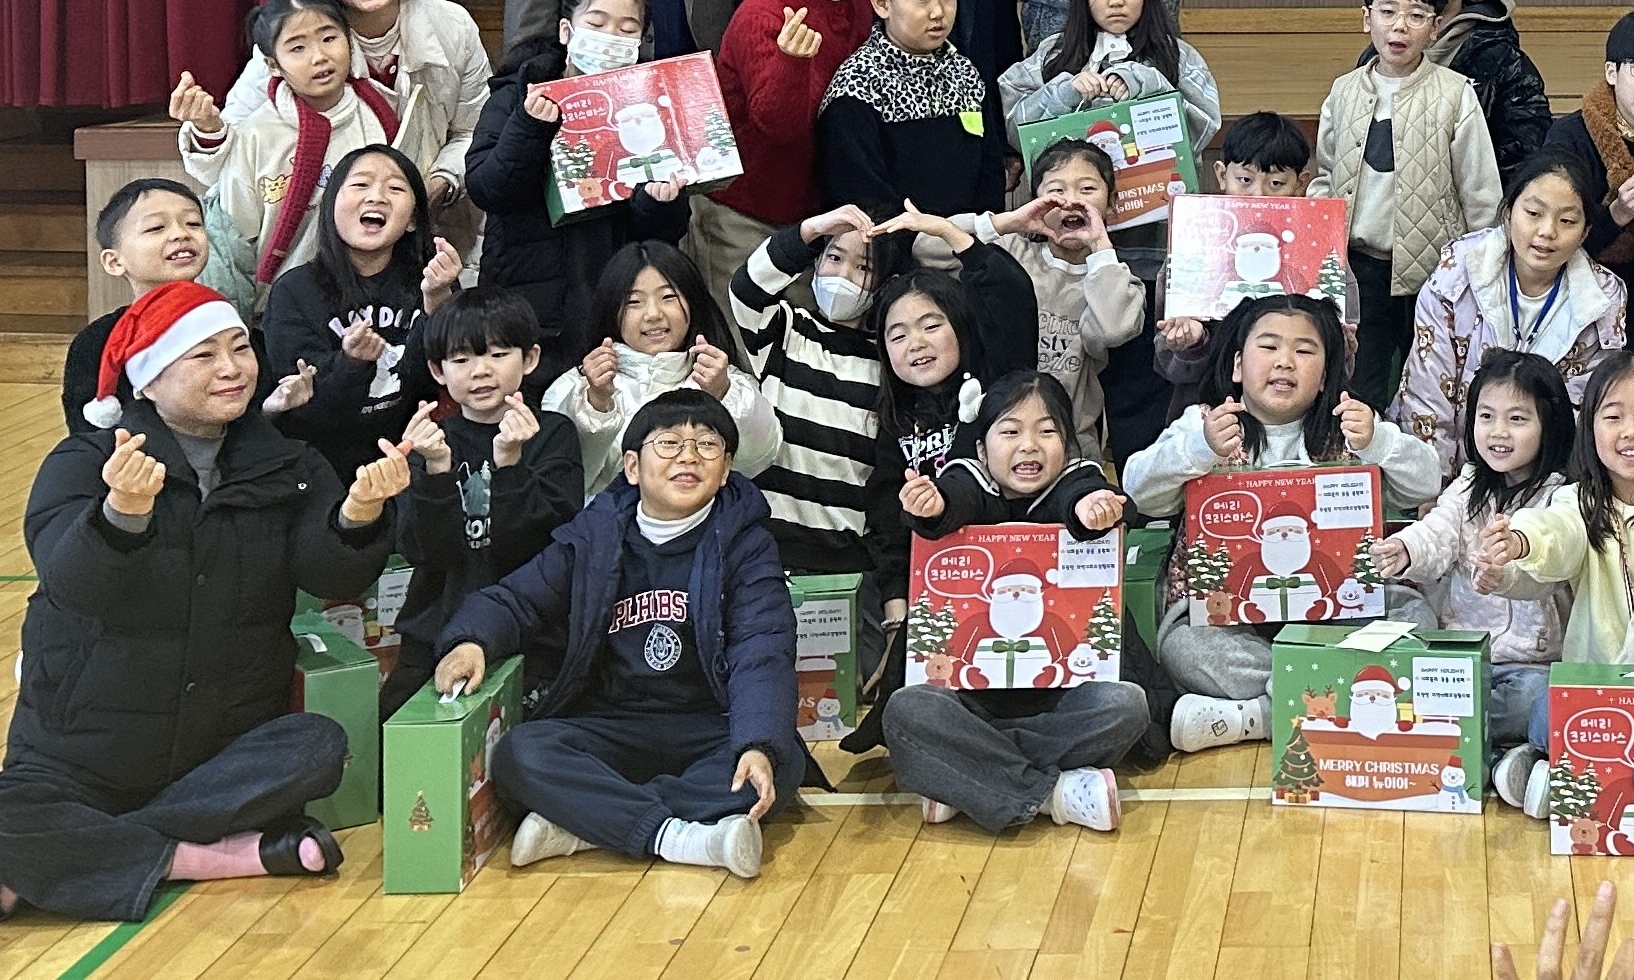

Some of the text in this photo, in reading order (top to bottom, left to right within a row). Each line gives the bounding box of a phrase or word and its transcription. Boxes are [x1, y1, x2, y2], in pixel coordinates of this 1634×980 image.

[1246, 479, 1274, 488] HAPPY
[1274, 479, 1294, 487] NEW
[1213, 500, 1240, 510] 메리
[1205, 512, 1254, 525] 크리스마스
[978, 534, 1056, 543] HAPPY NEW YEAR
[941, 556, 971, 566] 메리
[931, 569, 985, 581] 크리스마스
[1580, 718, 1611, 728] 메리
[1569, 730, 1627, 744] 크리스마스
[1319, 758, 1440, 775] MERRY CHRISTMAS
